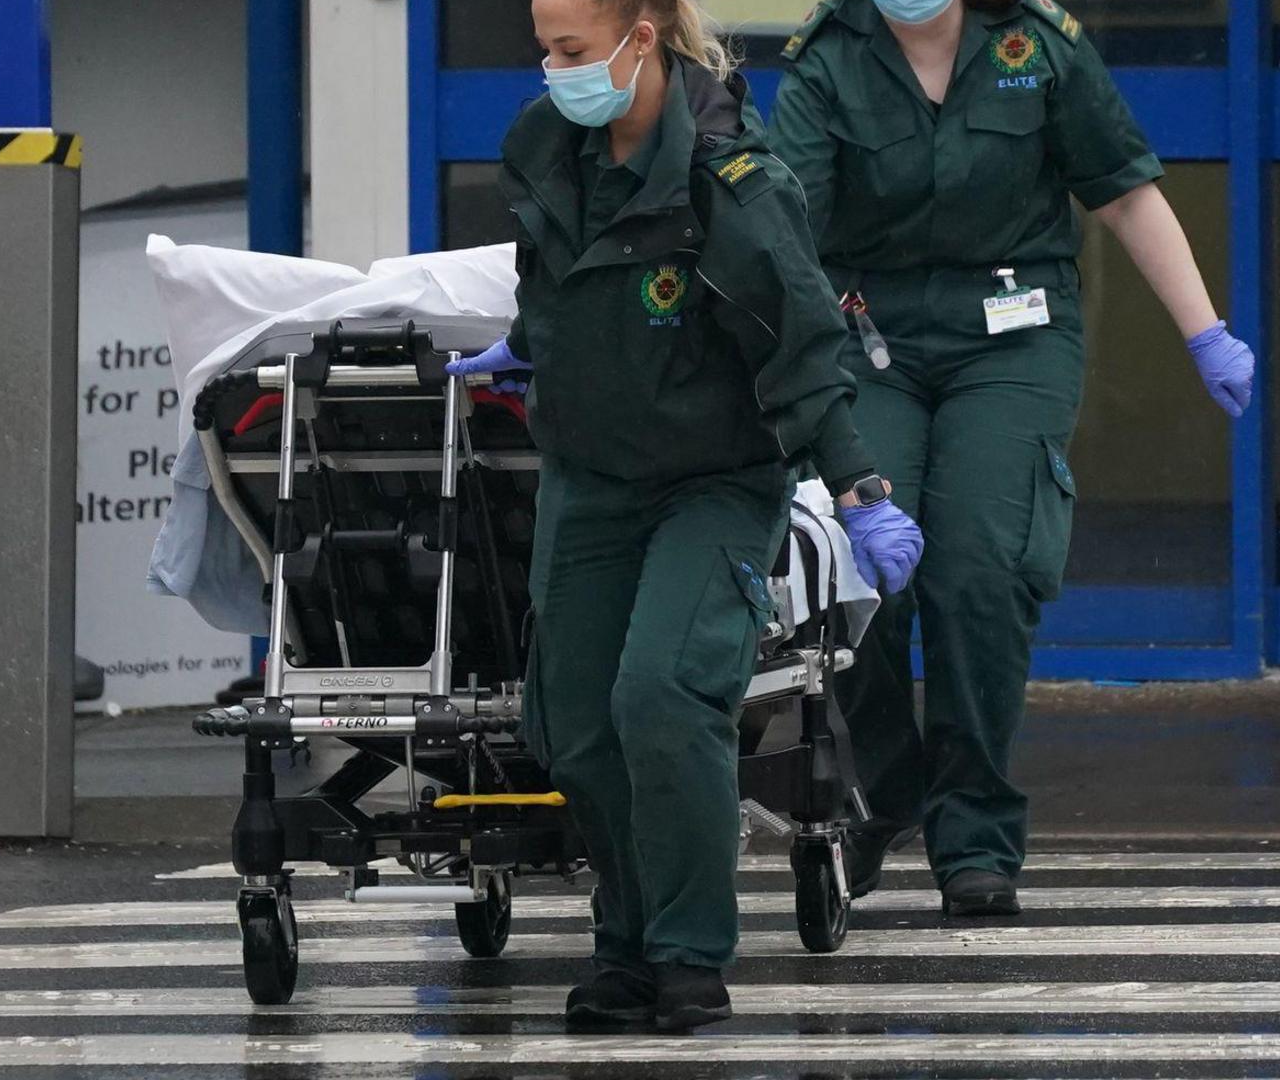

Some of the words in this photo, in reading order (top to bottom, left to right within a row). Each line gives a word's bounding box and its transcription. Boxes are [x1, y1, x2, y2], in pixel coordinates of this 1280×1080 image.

[998, 76, 1037, 88] ELITE
[649, 317, 681, 327] ELITE
[97, 340, 172, 370] thro
[84, 385, 139, 415] for
[129, 446, 178, 478] Ple
[77, 491, 172, 523] ltern
[103, 660, 170, 678] ologies
[177, 655, 204, 671] for
[210, 655, 243, 670] any
[320, 676, 379, 687] FERNO
[336, 717, 388, 728] FERNO
